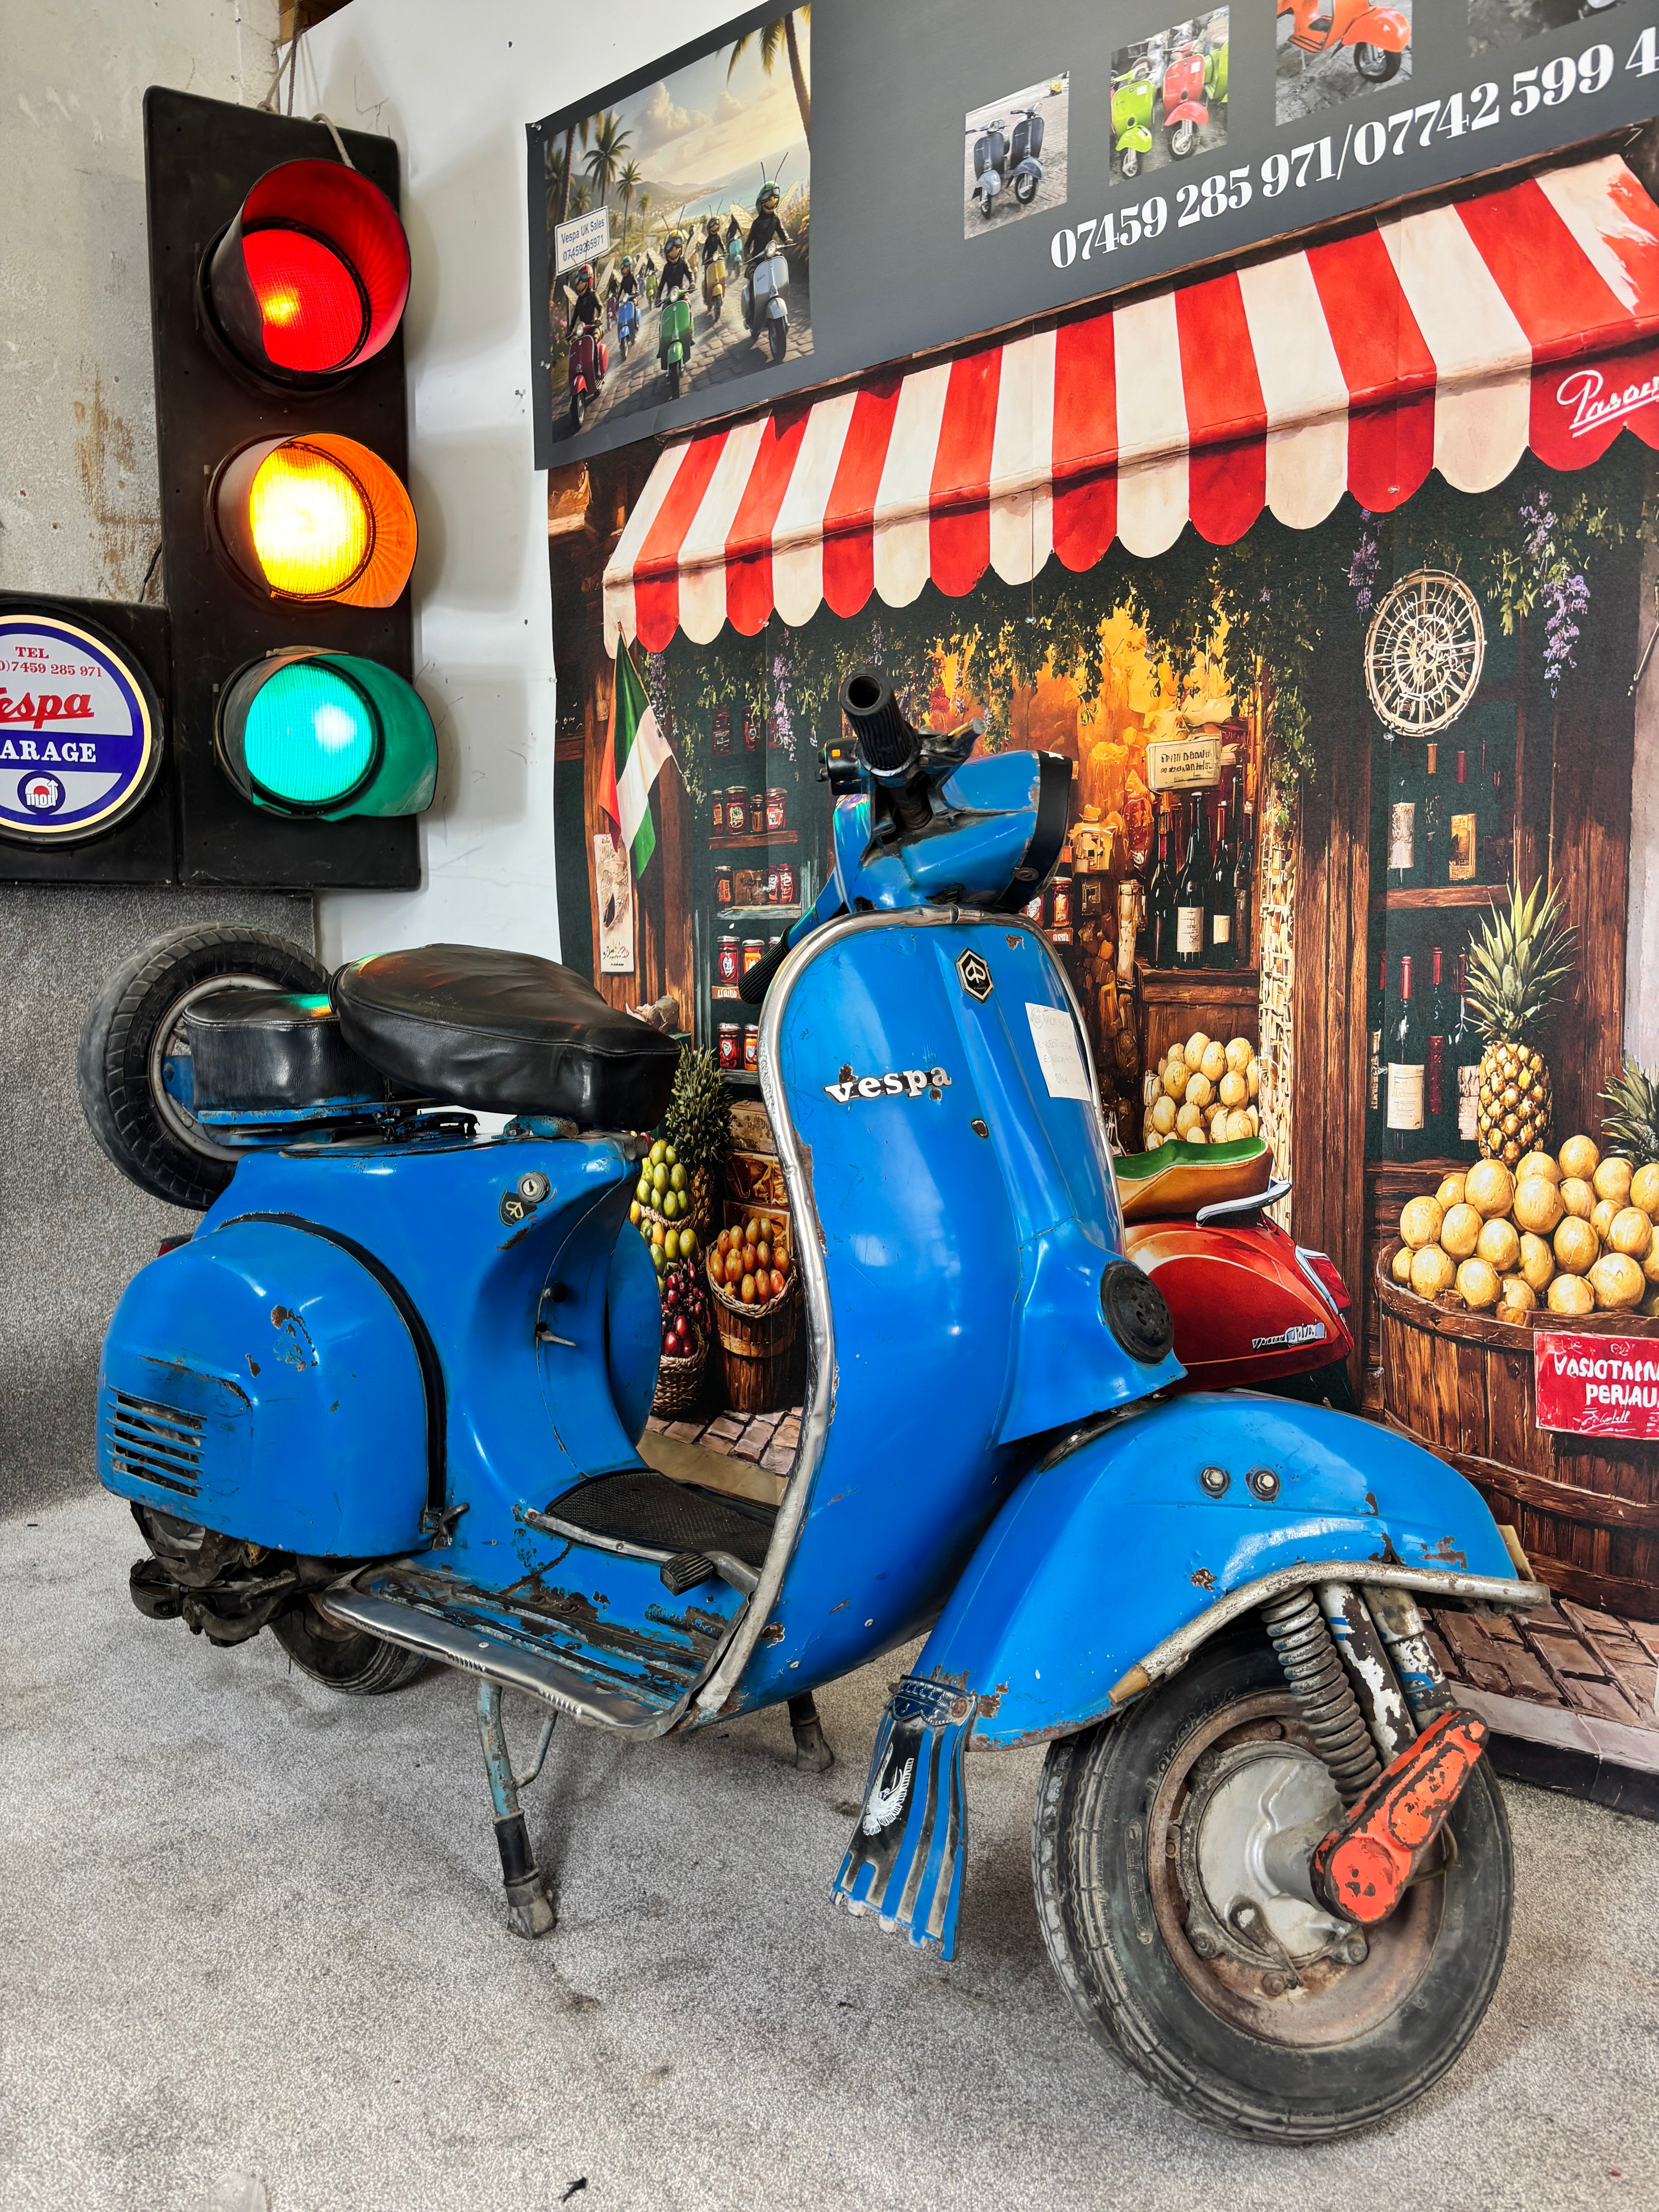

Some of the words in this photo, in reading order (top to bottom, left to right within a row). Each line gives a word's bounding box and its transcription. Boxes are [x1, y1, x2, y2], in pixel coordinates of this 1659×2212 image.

[1051, 196, 1167, 269] 07459
[1176, 164, 1252, 228] 285
[1510, 44, 1614, 116] 599
[561, 230, 579, 245] Vespa
[581, 223, 589, 236] UK
[590, 218, 604, 232] Sales
[563, 234, 604, 262] 07459285971
[15, 646, 49, 659] TEL
[51, 664, 76, 676] 285
[79, 666, 102, 677] 971
[0, 687, 95, 729] espa
[0, 739, 96, 763] ARAGE
[26, 784, 57, 806] mod
[825, 1067, 952, 1103] vespa
